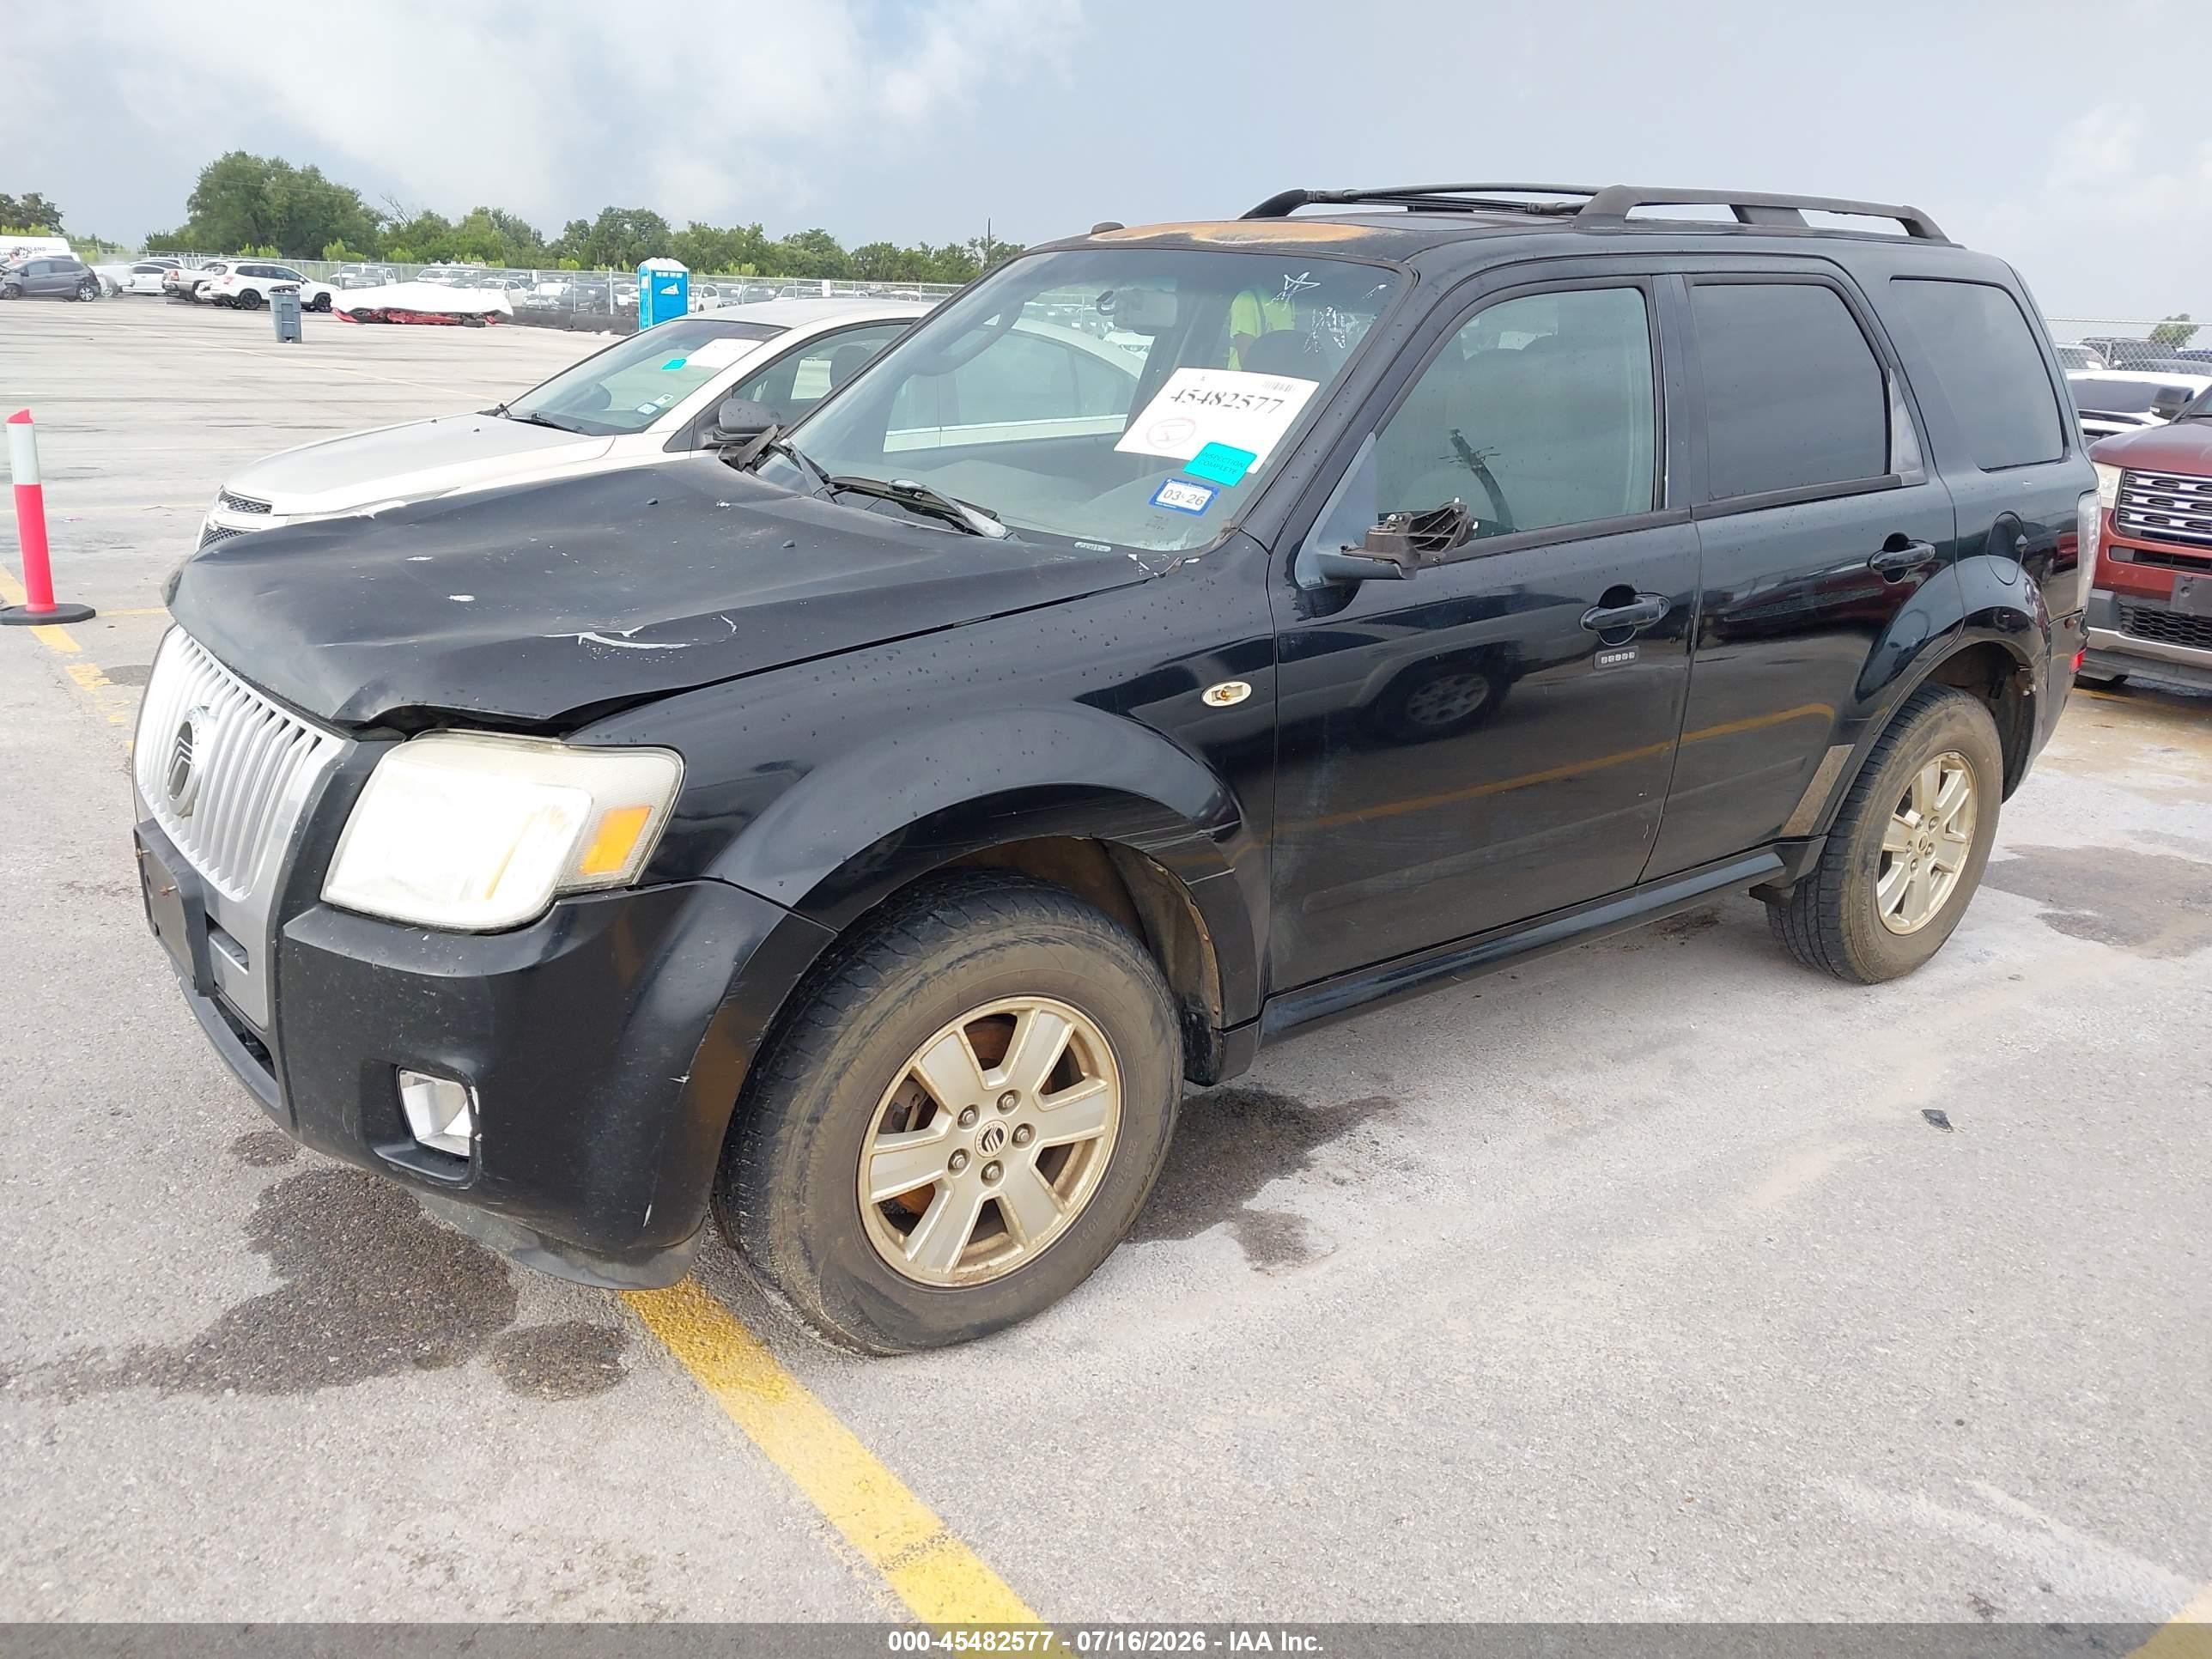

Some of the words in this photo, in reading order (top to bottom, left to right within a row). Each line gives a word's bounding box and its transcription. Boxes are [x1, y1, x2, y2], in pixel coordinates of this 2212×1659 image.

[1170, 389, 1285, 414] 45482577
[1199, 459, 1237, 475] COMPLETE
[1202, 452, 1245, 468] INSPECTION
